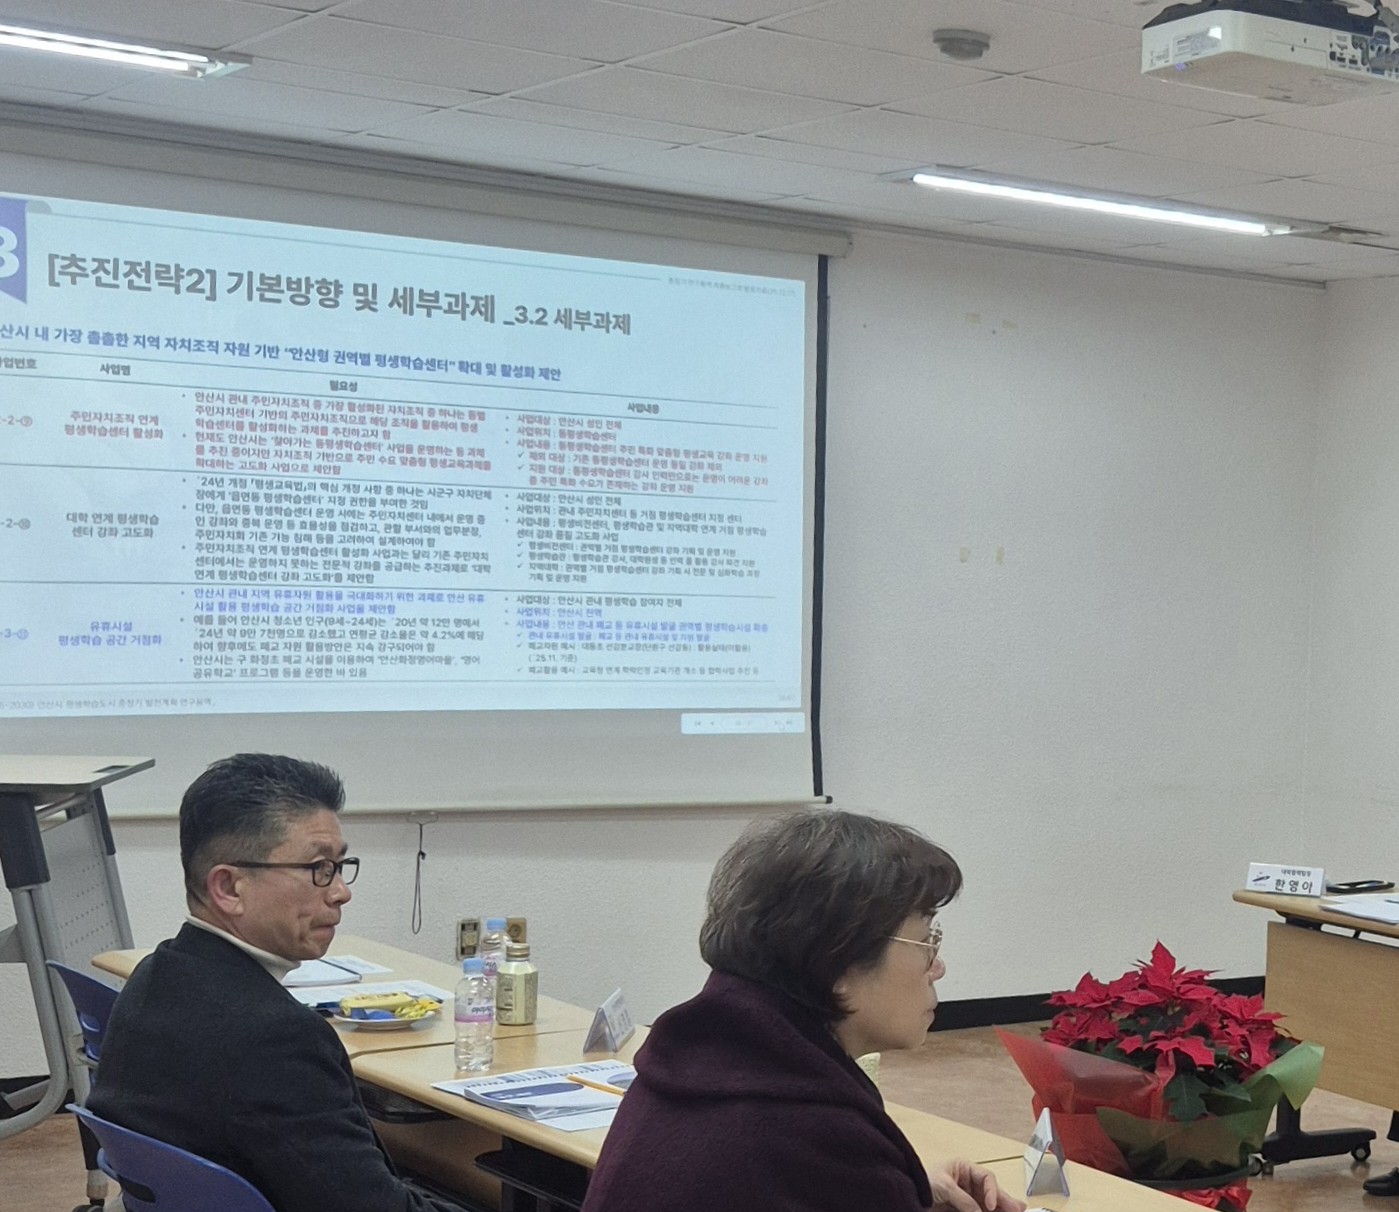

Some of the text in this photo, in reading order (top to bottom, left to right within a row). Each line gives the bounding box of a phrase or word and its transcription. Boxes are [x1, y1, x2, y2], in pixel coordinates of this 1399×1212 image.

[47, 250, 217, 302] [추진전략2]
[226, 268, 343, 310] 기본방향
[352, 280, 378, 313] 및
[387, 284, 495, 324] 세부과제
[553, 306, 630, 335] 세부과제
[34, 325, 48, 341] 내
[54, 326, 83, 344] 가장
[133, 333, 160, 350] 지역
[164, 335, 219, 354] 자치조직
[223, 340, 250, 357] 자원
[254, 343, 280, 359] 기반
[333, 349, 370, 366] 권역별
[458, 360, 482, 375] 확대
[485, 362, 496, 376] 및
[500, 363, 535, 379] 활성화
[538, 366, 561, 381] 제안
[99, 362, 130, 376] 사업명
[329, 379, 357, 392] 필요성
[66, 511, 159, 526] 대학 연계 평생학습
[72, 525, 153, 538] 센터 강좌 고도화
[90, 620, 132, 632] 유휴시설
[58, 634, 162, 646] 평생학습 공간 거점화
